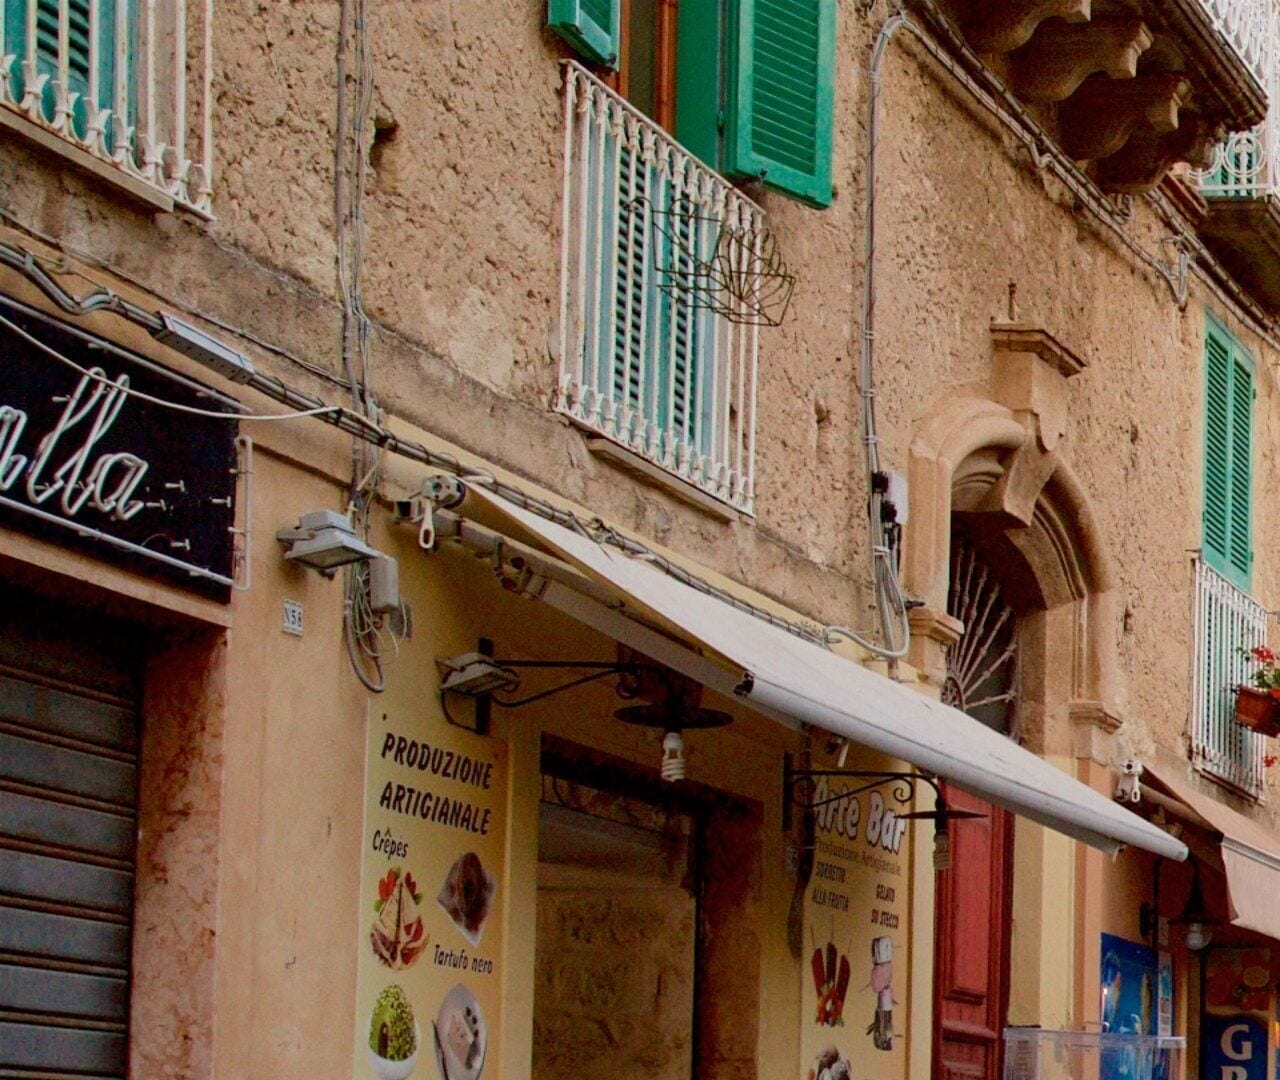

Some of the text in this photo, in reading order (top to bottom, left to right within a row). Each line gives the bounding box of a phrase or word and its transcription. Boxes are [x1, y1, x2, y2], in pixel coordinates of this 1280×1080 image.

[381, 732, 493, 790] PRODUZIONE
[380, 780, 491, 836] ARTIGIANALE
[372, 826, 409, 861] Crêpes
[433, 944, 493, 975] Tartufo nero
